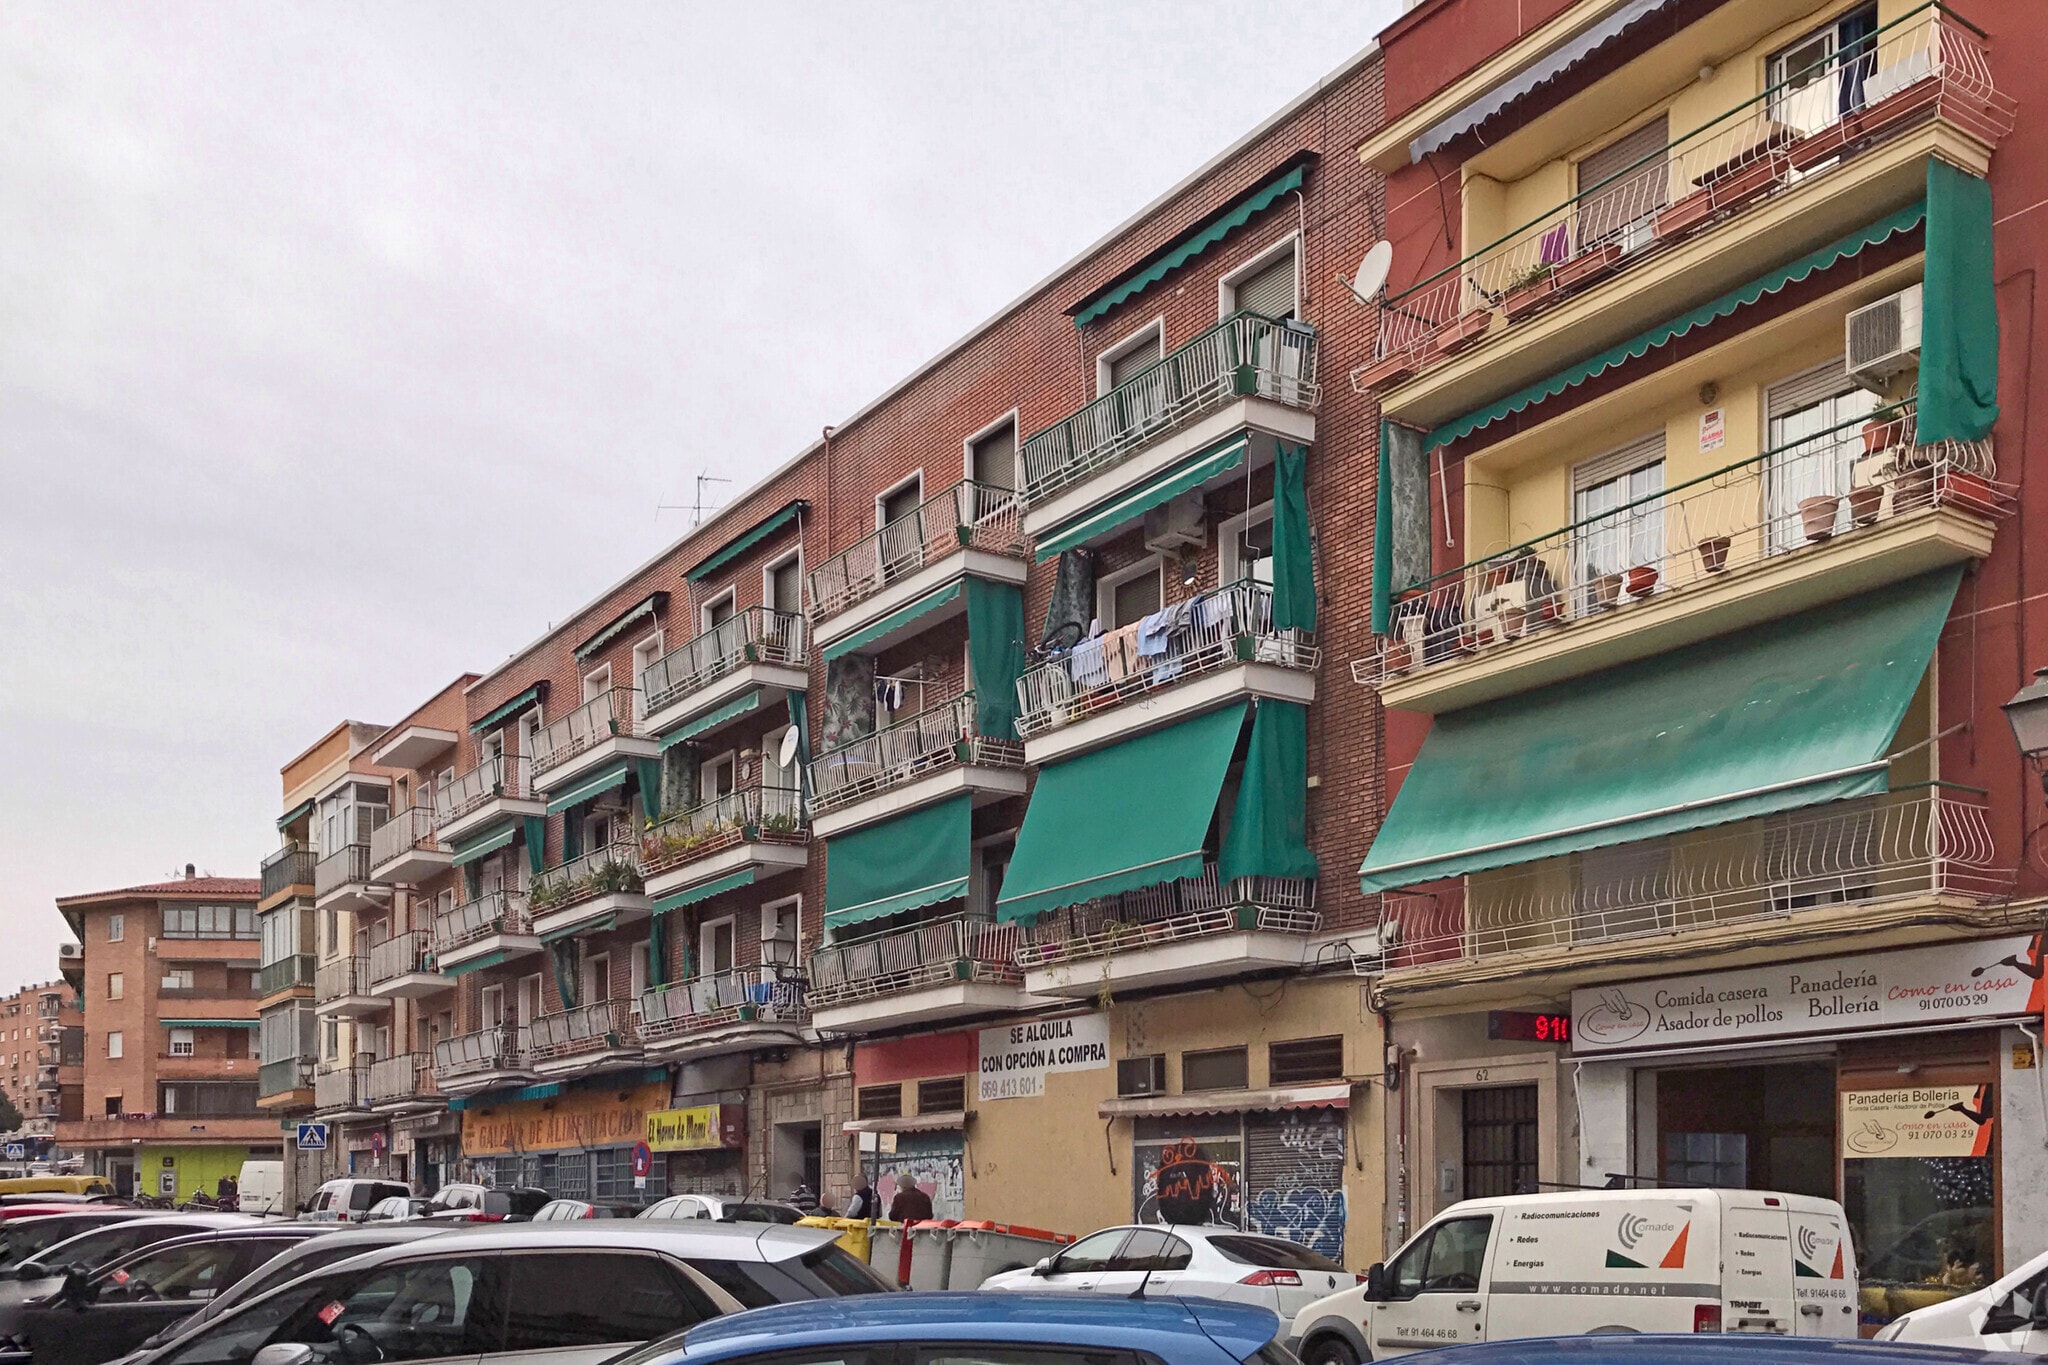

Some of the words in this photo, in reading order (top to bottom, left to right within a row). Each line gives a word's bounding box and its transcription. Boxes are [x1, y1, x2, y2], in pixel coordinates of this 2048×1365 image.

[1790, 969, 1877, 995] Panadería
[1888, 984, 1940, 1001] Como
[1945, 982, 1969, 994] en
[1974, 976, 2019, 991] casa
[1655, 986, 1715, 1009] Comida
[1717, 987, 1768, 1002] casera
[1808, 995, 1879, 1018] Bollería
[1655, 1009, 1709, 1033] Asador
[1712, 1008, 1732, 1028] de
[1735, 1004, 1783, 1030] pollos
[1010, 1027, 1023, 1044] SE
[1026, 1020, 1073, 1043] ALQUILA
[982, 1055, 1003, 1073] CON
[1005, 1047, 1045, 1071] OPCIÓN
[1048, 1049, 1056, 1066] A
[1058, 1043, 1106, 1065] COMPRA
[1476, 1069, 1489, 1081] 62
[981, 1080, 997, 1099] 669
[1000, 1078, 1017, 1097] 413
[1020, 1076, 1036, 1095] 601
[1848, 1091, 1909, 1105] Panadería
[1912, 1089, 1960, 1102] Bollería
[529, 1120, 544, 1145] DE
[1895, 1121, 1924, 1131] Como
[1943, 1121, 1968, 1129] casa
[1908, 1131, 1919, 1140] 91
[1923, 1130, 1941, 1140] 070
[1961, 1129, 1974, 1139] 29
[1521, 1210, 1600, 1220] Radiocomunicaciones
[1516, 1236, 1539, 1244] Redes
[1529, 1284, 1666, 1295] www.comade.net
[1729, 1300, 1762, 1309] TRANSIT
[1411, 1328, 1419, 1337] 91
[1421, 1328, 1435, 1338] 464
[1436, 1329, 1446, 1338] 46
[1447, 1329, 1457, 1339] 68
